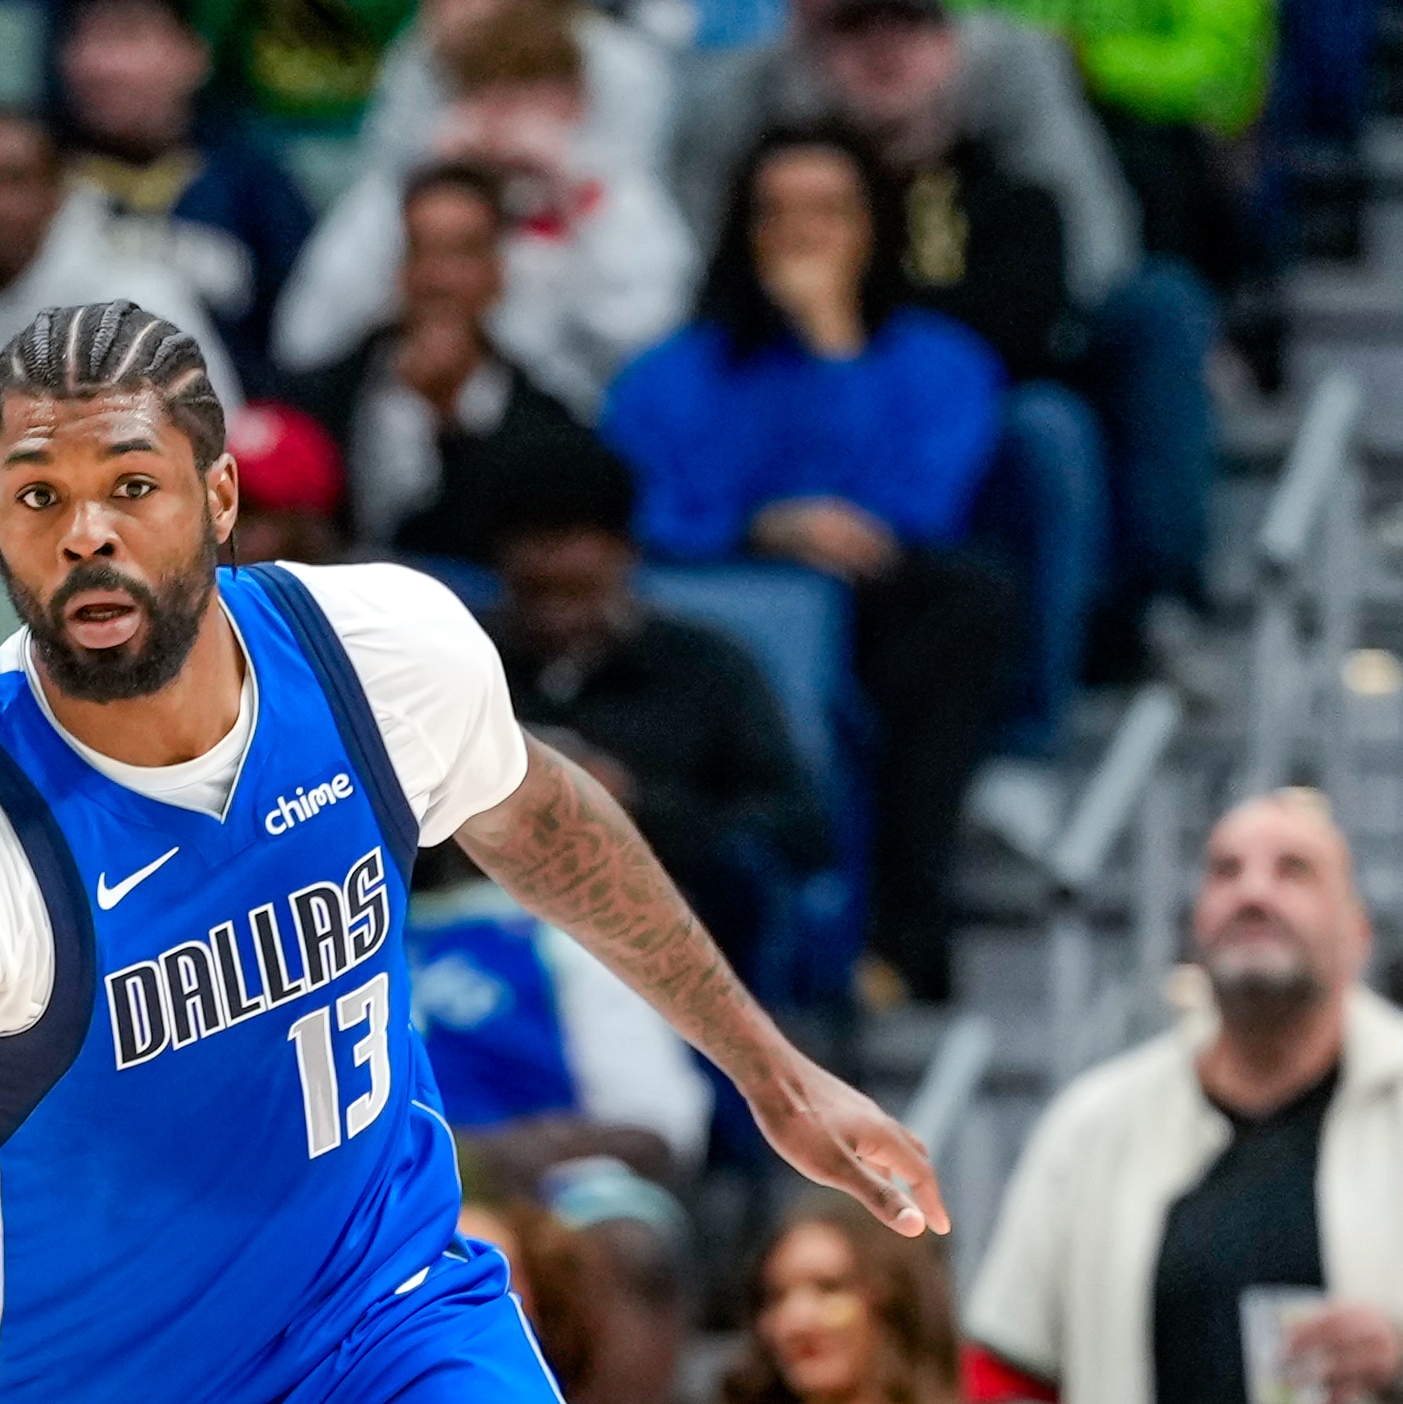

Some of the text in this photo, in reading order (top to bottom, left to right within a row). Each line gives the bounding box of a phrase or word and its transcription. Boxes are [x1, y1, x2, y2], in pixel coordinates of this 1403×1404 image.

[264, 771, 356, 837] chime
[104, 846, 391, 1071] DALLAS
[287, 971, 392, 1161] 13
